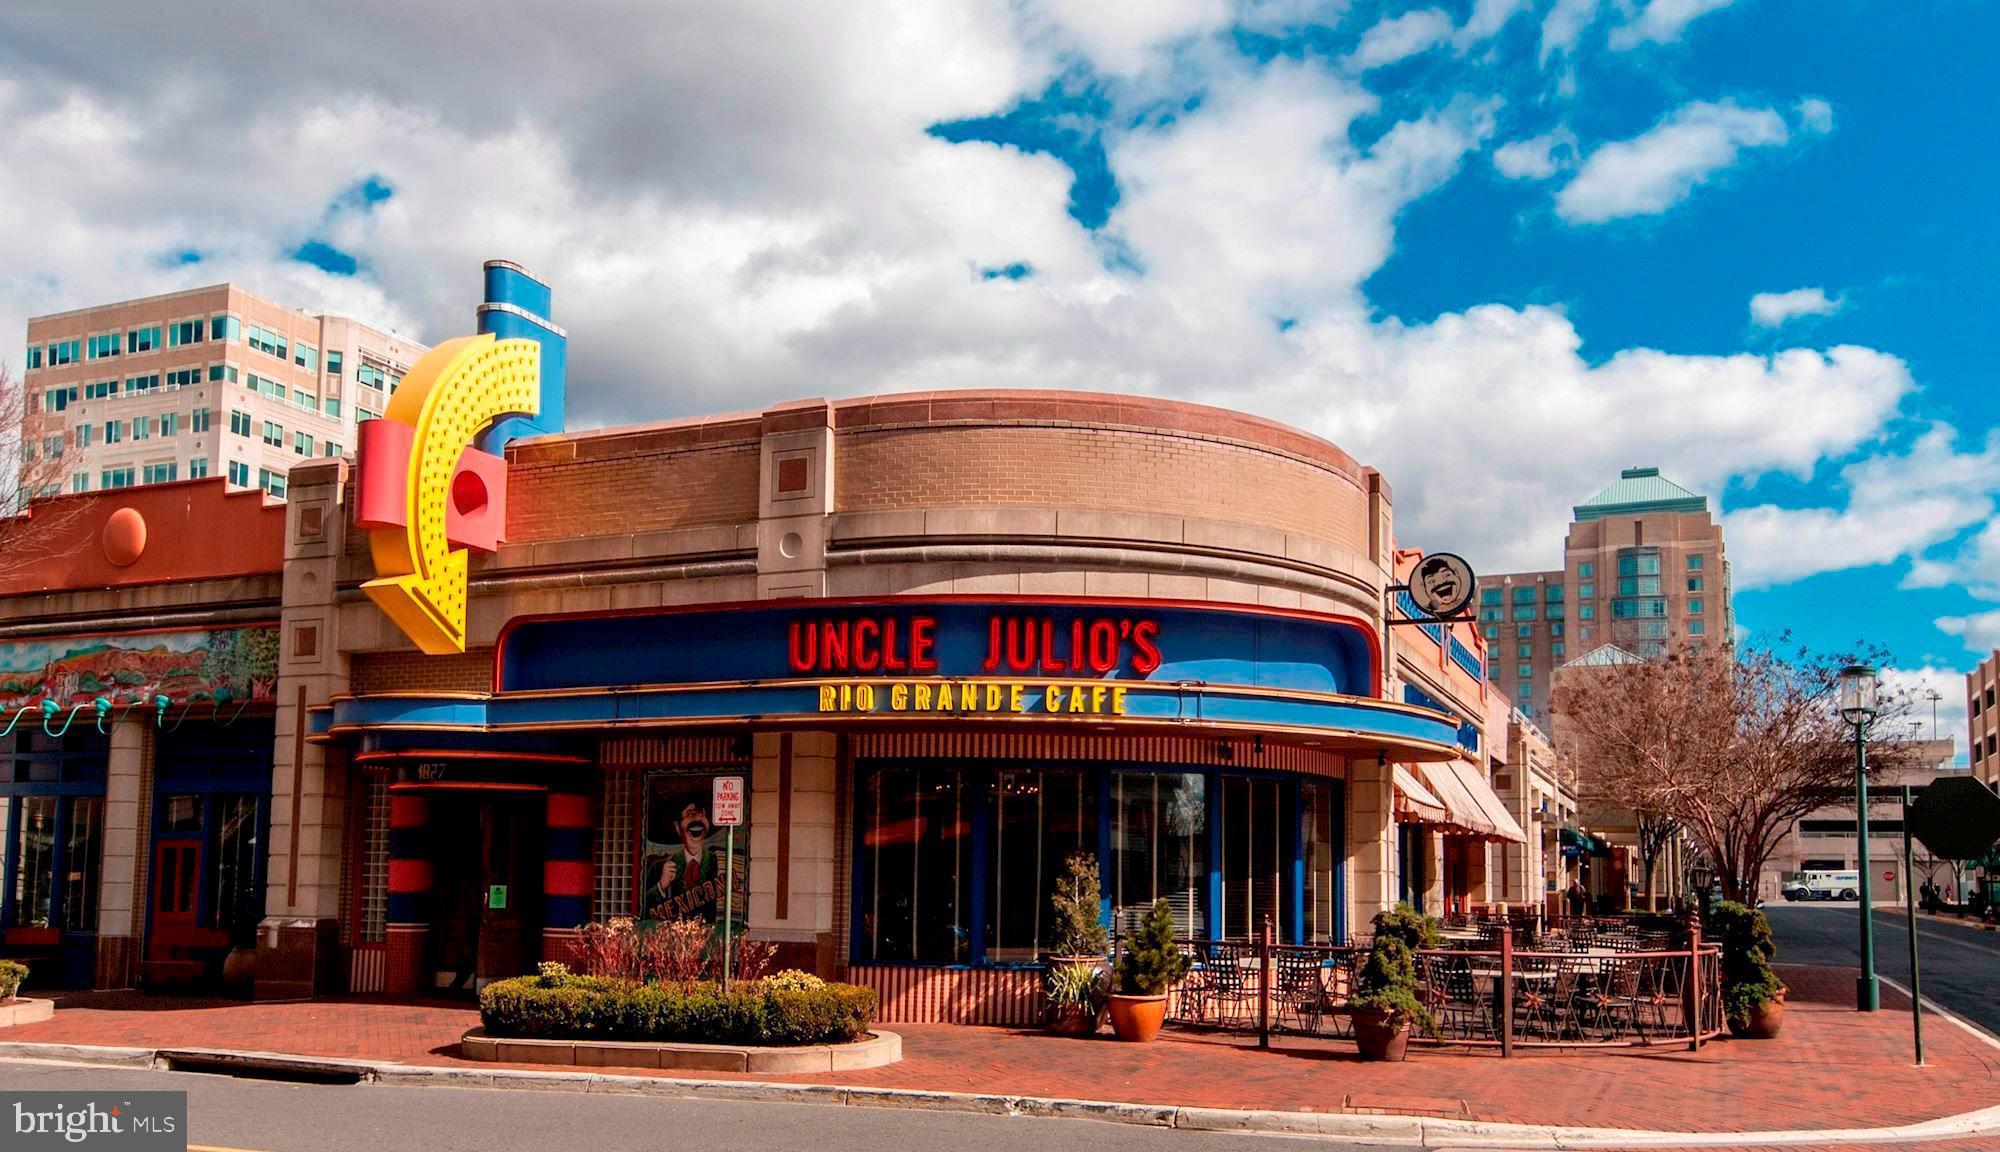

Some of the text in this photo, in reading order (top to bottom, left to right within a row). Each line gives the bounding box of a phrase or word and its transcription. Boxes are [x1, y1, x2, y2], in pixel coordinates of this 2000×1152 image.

[789, 616, 1161, 673] UNCLE JULIO'S
[819, 683, 1127, 714] RIO GRANDE CAFE
[418, 763, 447, 779] 1827
[723, 781, 733, 791] NO
[717, 792, 739, 801] PARKING
